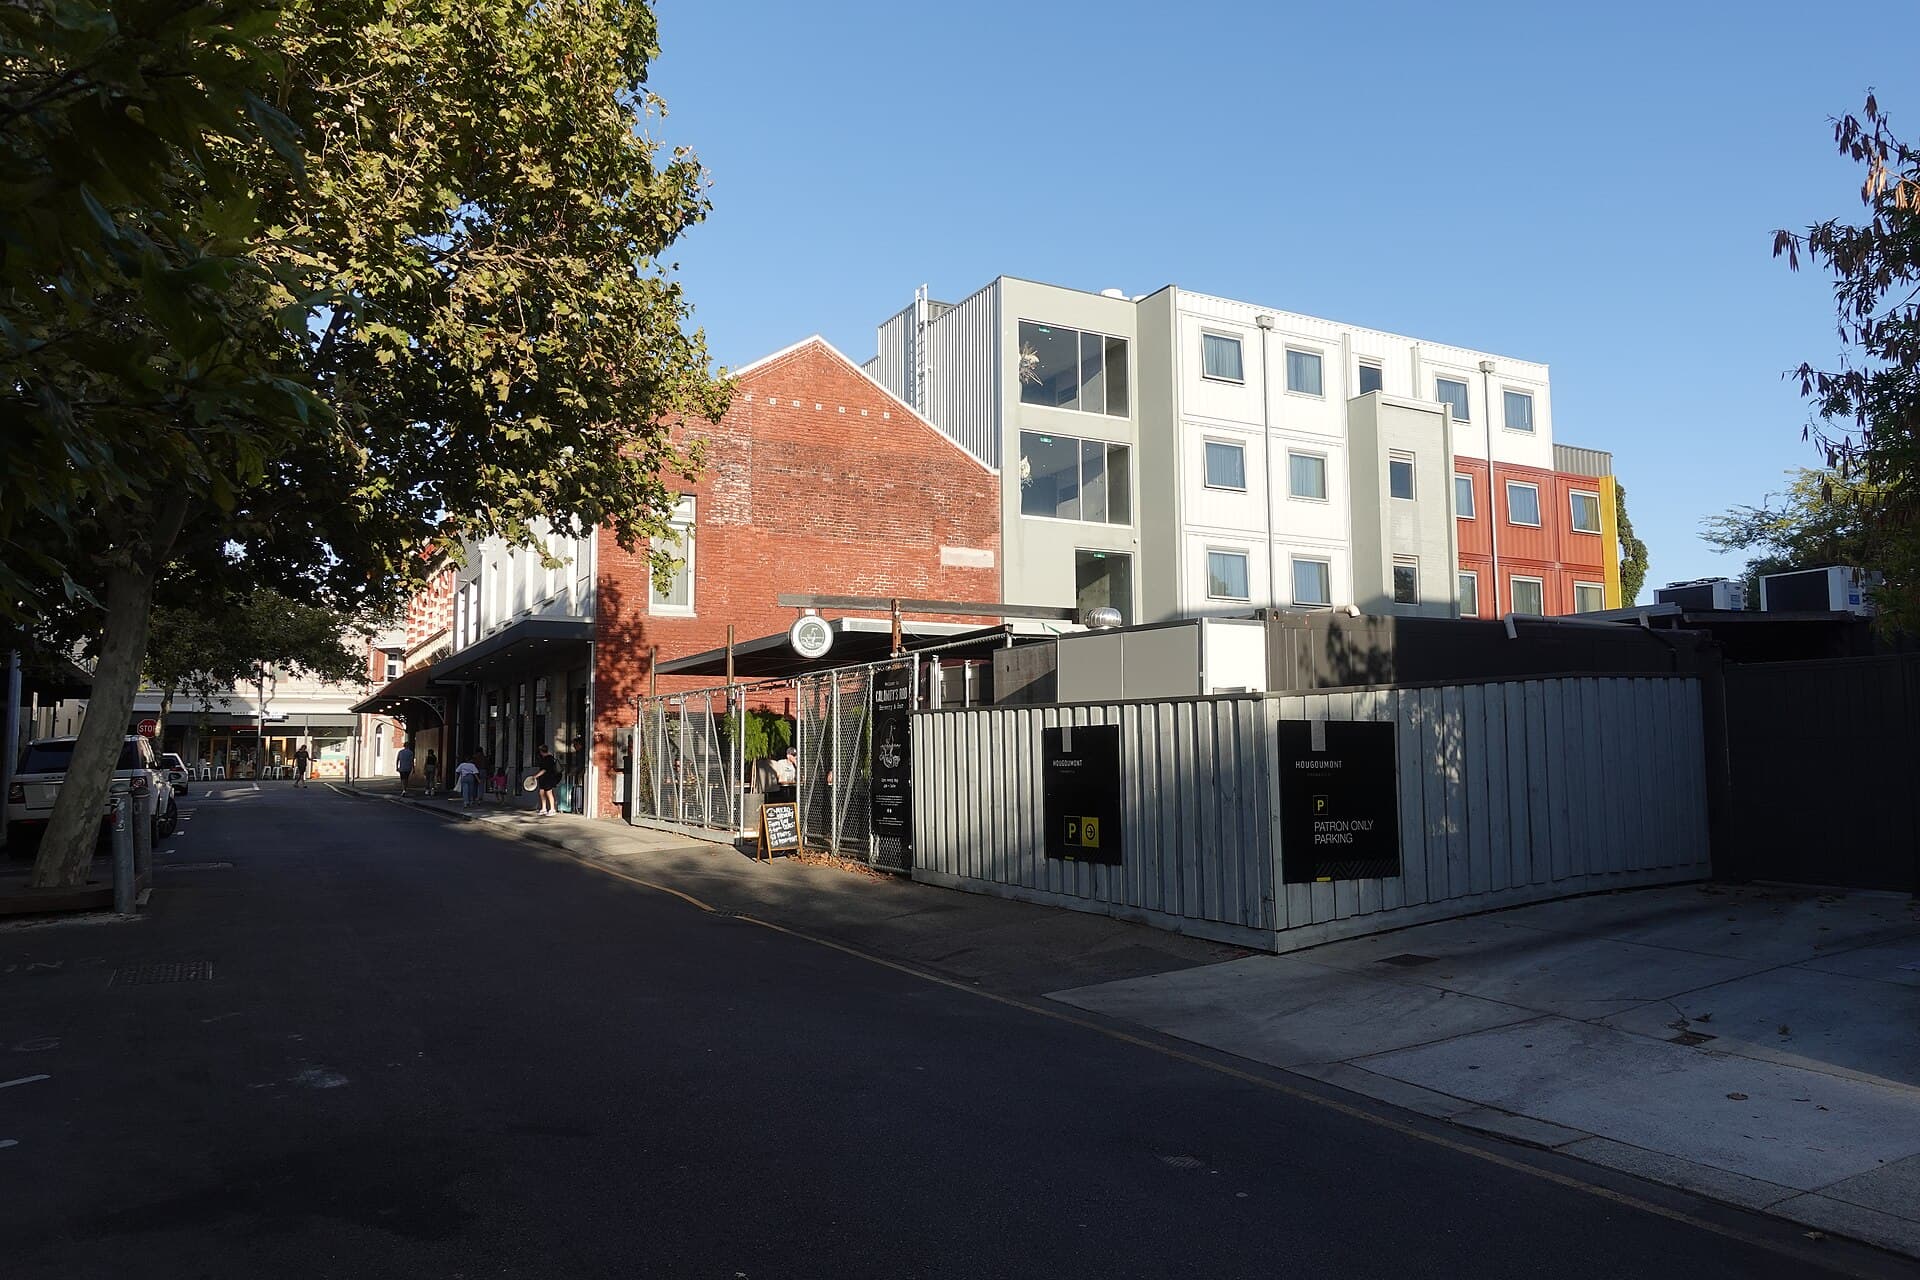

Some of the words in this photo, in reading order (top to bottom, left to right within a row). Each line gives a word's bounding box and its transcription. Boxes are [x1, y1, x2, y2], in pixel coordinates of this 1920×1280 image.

[1052, 759, 1083, 767] HOUGOUMONT
[1295, 760, 1342, 769] HOUGOUMONT
[1317, 799, 1325, 811] P
[1068, 822, 1077, 839] P
[1314, 820, 1349, 833] PATRON
[1350, 819, 1374, 831] ONLY
[1314, 832, 1353, 845] PARKING
